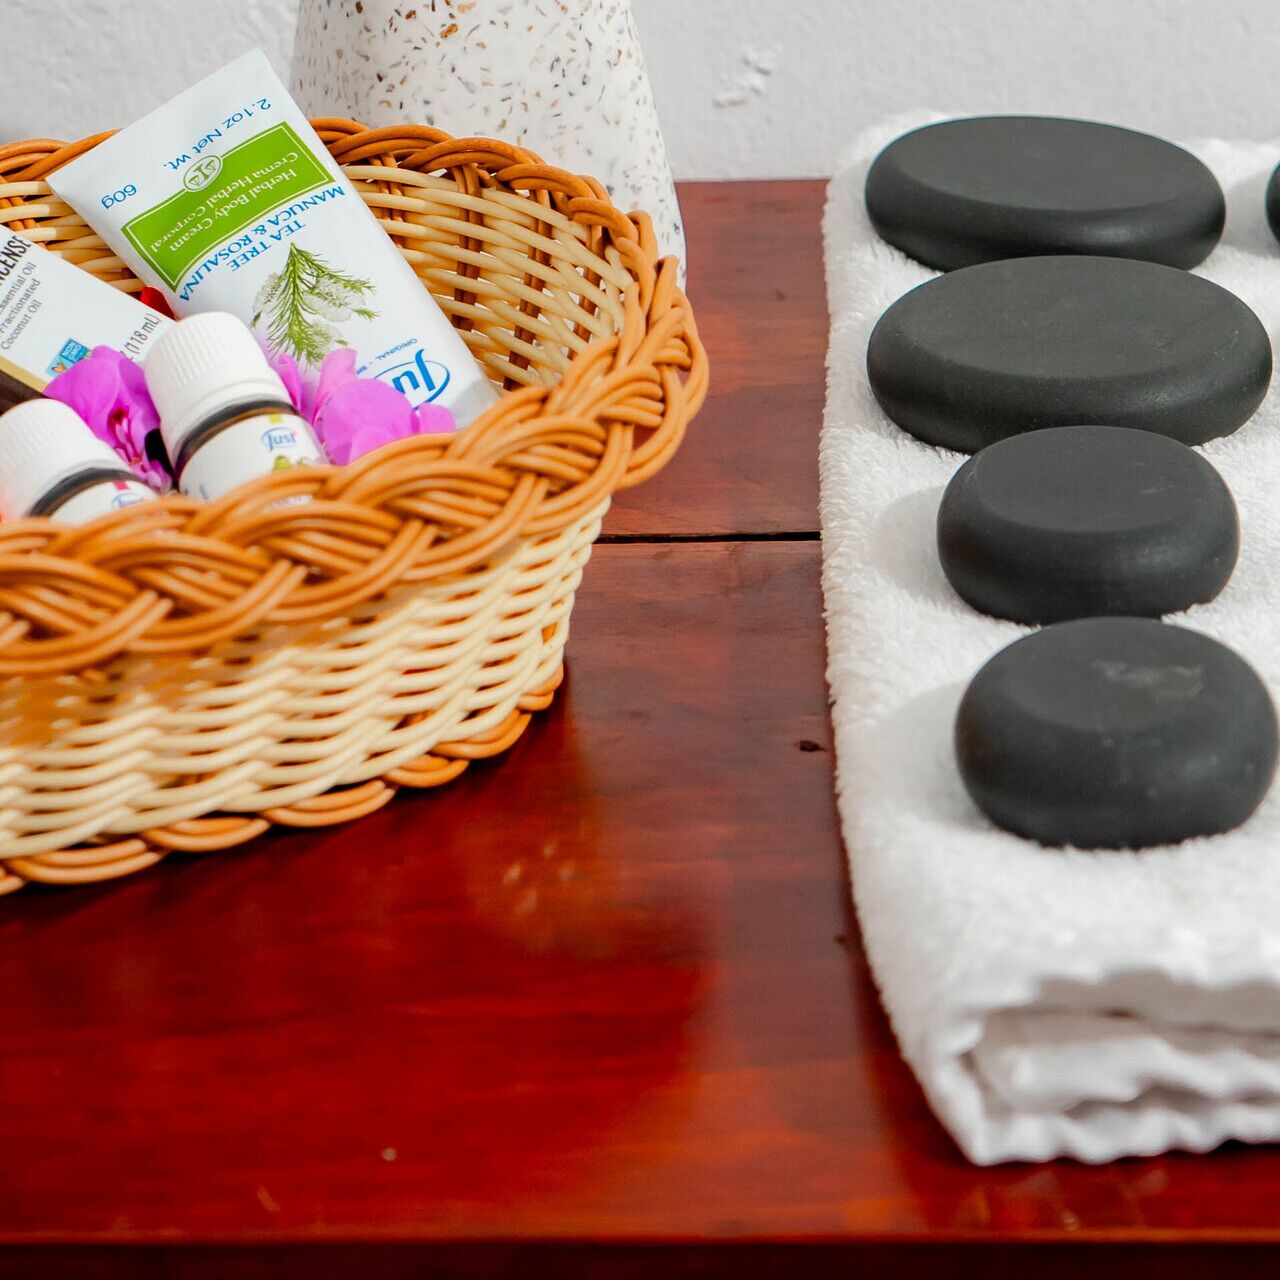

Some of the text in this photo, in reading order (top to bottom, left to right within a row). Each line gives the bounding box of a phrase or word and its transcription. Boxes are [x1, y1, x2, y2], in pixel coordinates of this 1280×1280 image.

[222, 98, 271, 129] 2.1oz
[192, 128, 222, 154] Net
[100, 184, 137, 209] 60g
[150, 151, 299, 253] Crema Herbal Corporal
[169, 168, 298, 252] Herbal Body Cream
[179, 186, 346, 302] MANUCA & ROSALINA
[228, 220, 306, 272] TEA TREE
[22, 261, 37, 278] Oil
[0, 299, 42, 351] Coconut Oil
[124, 330, 149, 354] (118
[142, 312, 161, 334] mL)
[375, 338, 418, 361] ORIGINAL
[391, 348, 437, 394] Ju
